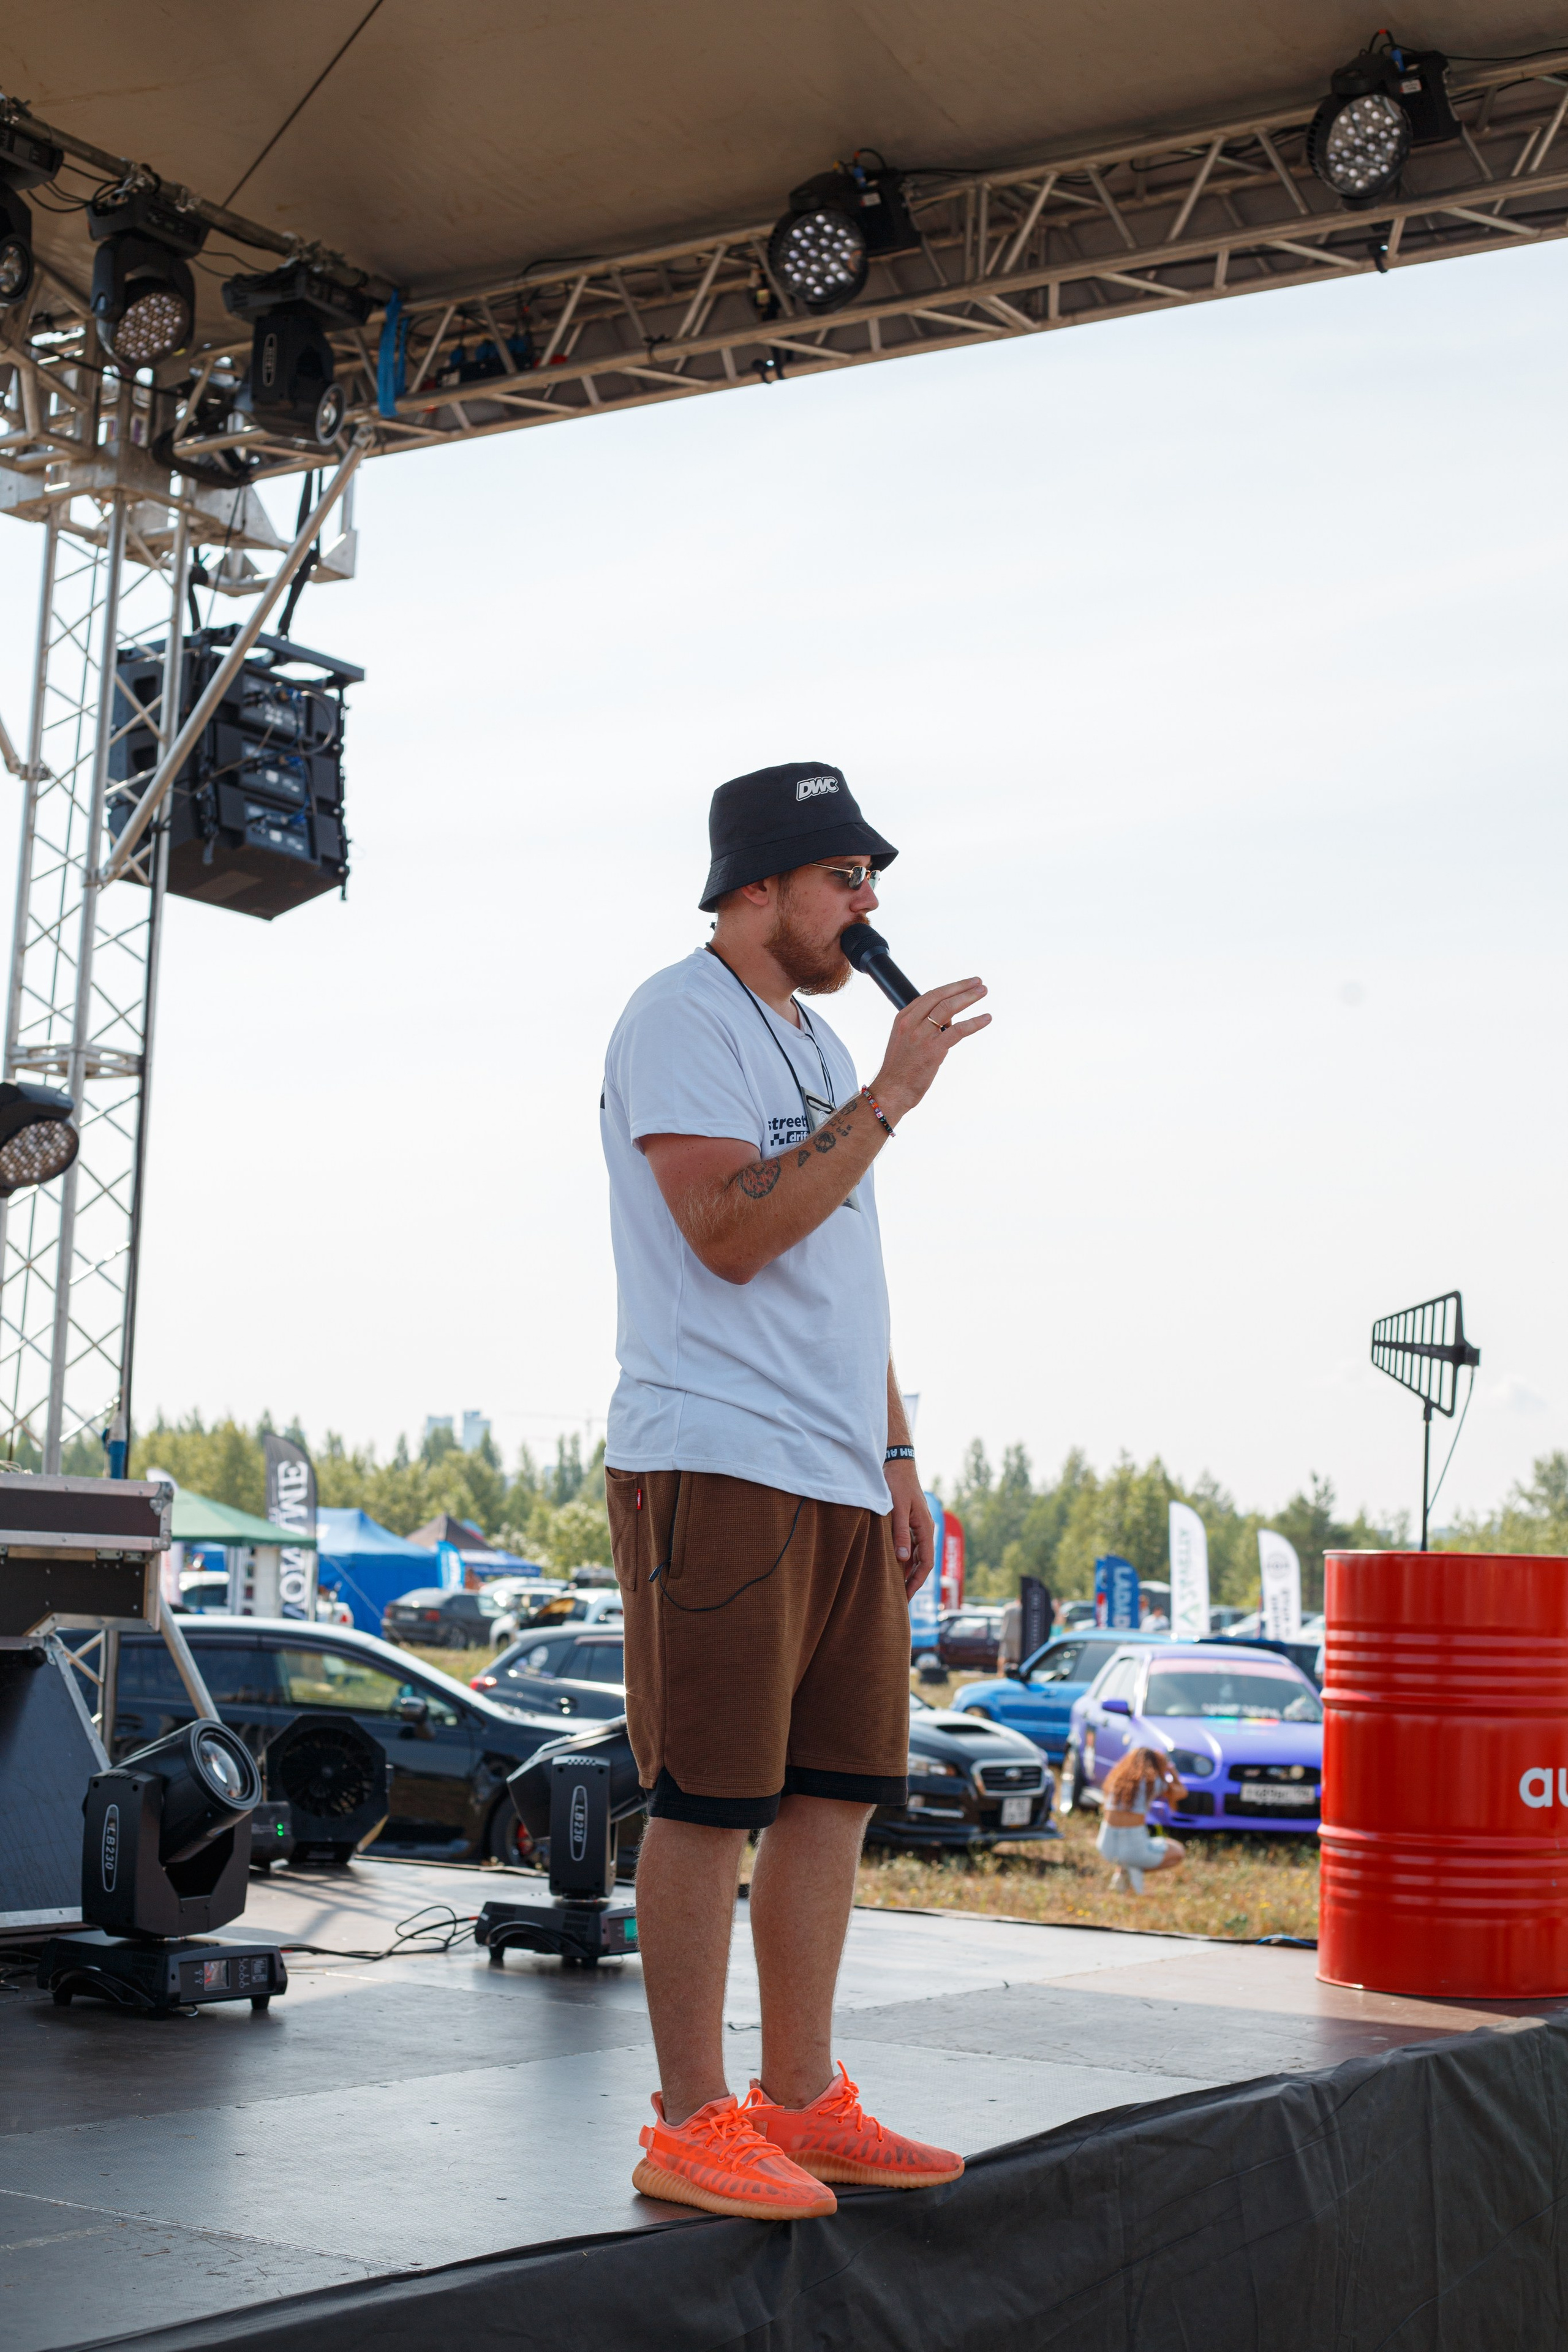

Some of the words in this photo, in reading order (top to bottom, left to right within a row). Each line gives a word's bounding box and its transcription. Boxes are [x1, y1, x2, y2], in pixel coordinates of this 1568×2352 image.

[797, 777, 838, 800] DWC
[573, 1805, 584, 1842] LB230
[105, 1827, 116, 1870] LB230
